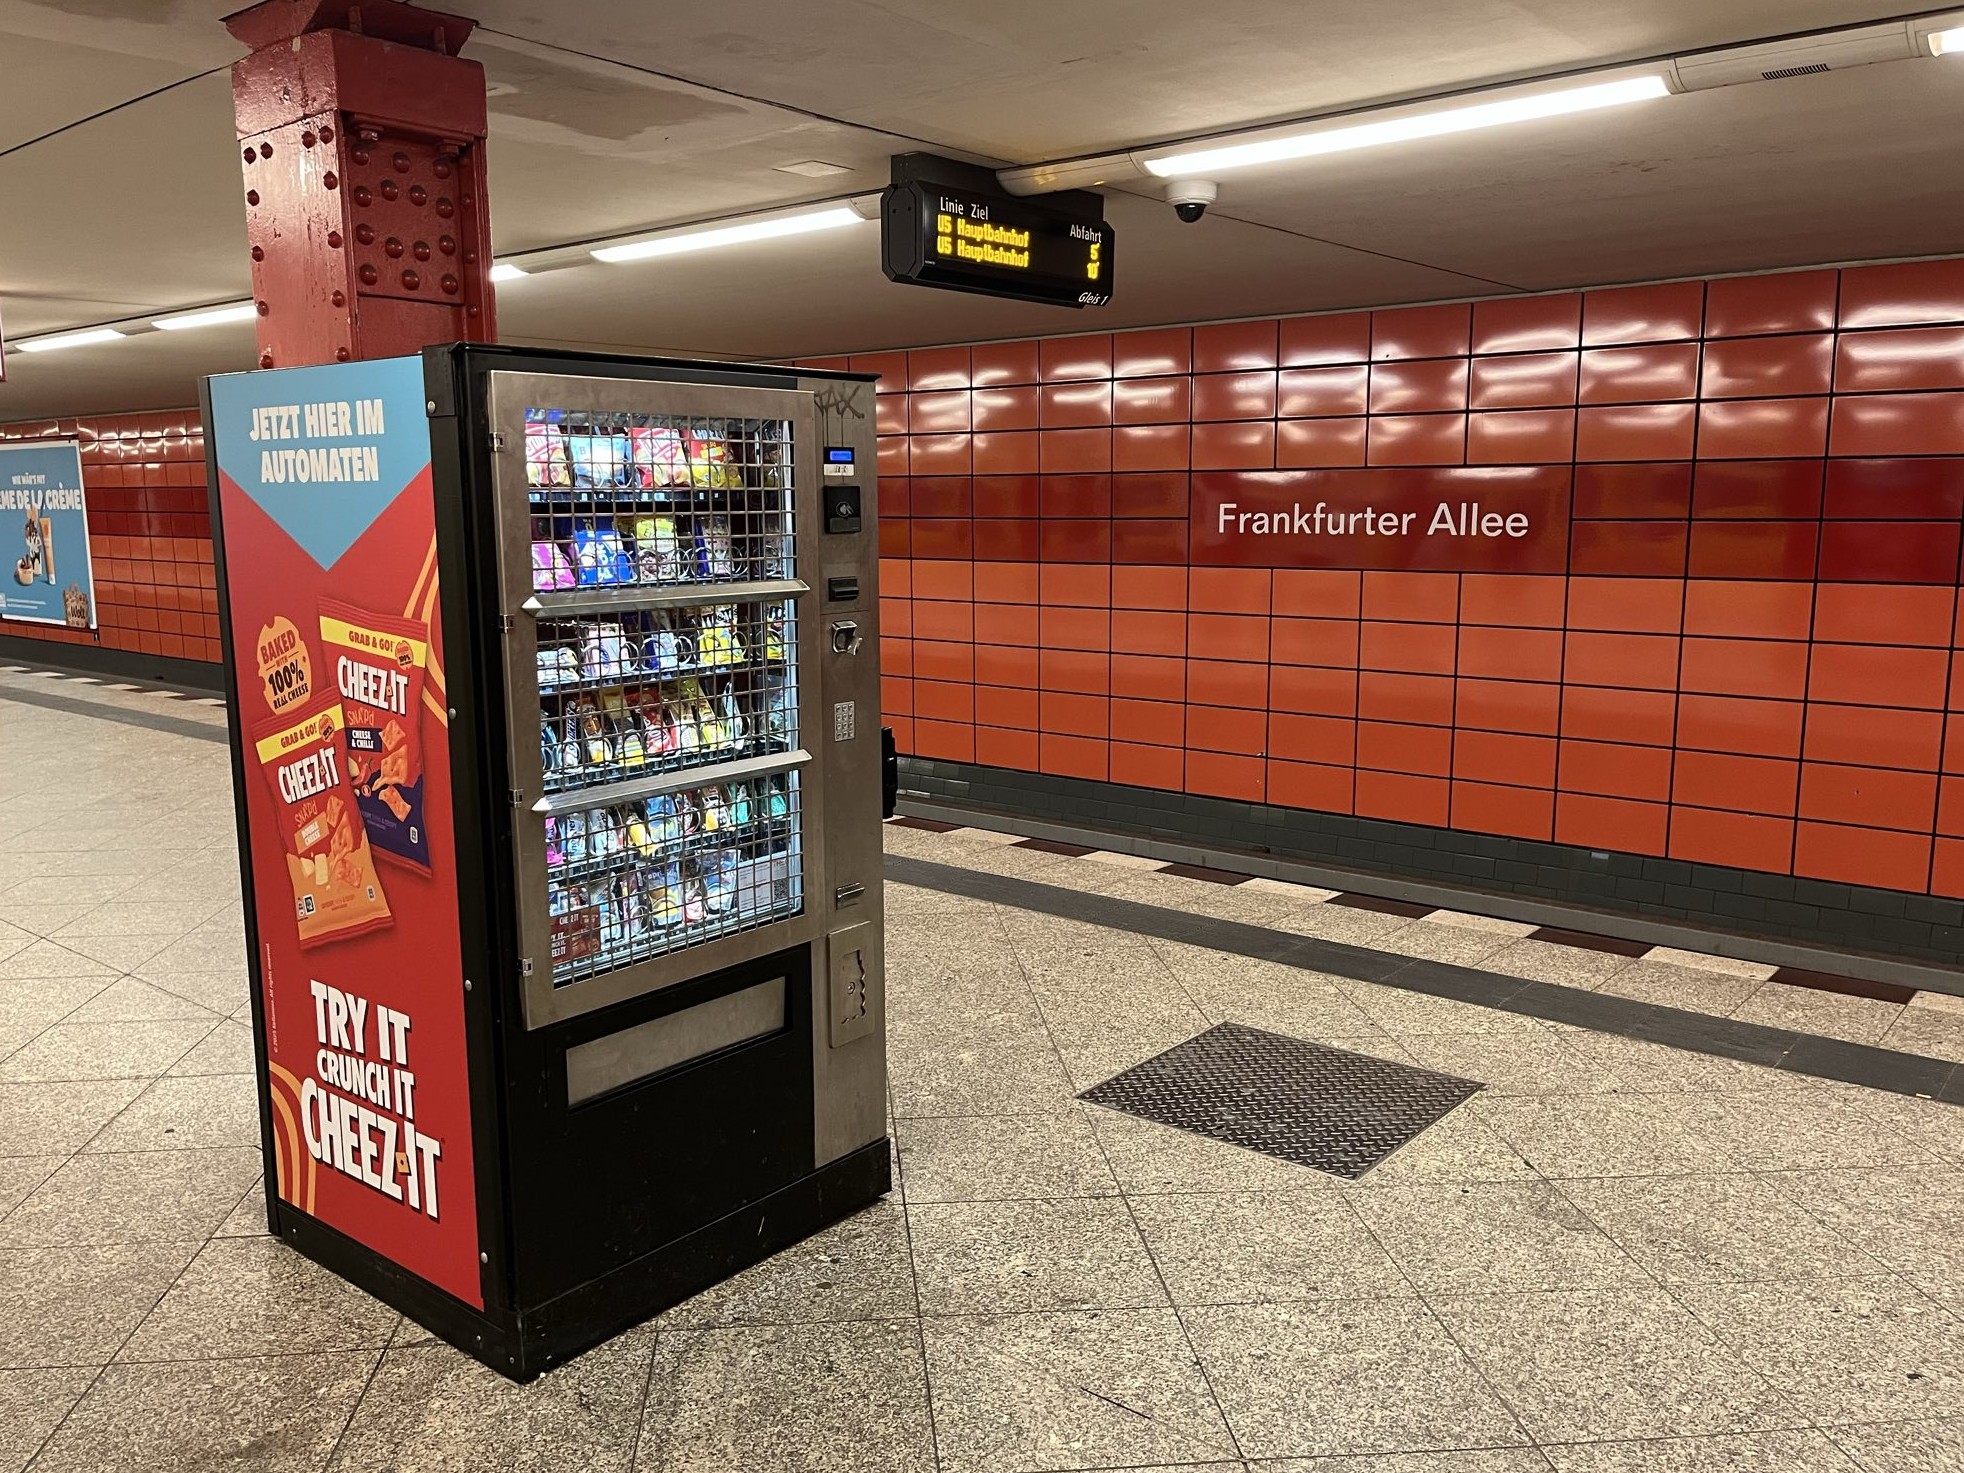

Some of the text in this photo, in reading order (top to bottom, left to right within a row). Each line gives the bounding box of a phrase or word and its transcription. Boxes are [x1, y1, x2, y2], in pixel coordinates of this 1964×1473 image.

[940, 196, 988, 220] Linie Ziel
[937, 214, 1029, 248] U5 Hauptbahnhof
[1069, 224, 1102, 244] Abfahrt
[937, 235, 1029, 268] U5 Hauptbahnhof
[1078, 292, 1101, 305] Gleis
[249, 399, 385, 441] JETZT HIER IM
[261, 446, 379, 484] AUTOMATEN
[17, 489, 30, 510] DE
[45, 482, 82, 510] CRÈME
[1218, 502, 1529, 538] Frankfurter Allee
[260, 629, 296, 664] BAKED
[348, 630, 370, 647] GRAB
[371, 637, 378, 649] &
[379, 638, 394, 653] GO!
[268, 659, 305, 696] 100%
[273, 683, 309, 710] REAL CHEESE
[280, 732, 299, 748] GRAB
[299, 729, 305, 740] &
[310, 979, 411, 1066] TRY IT
[316, 1048, 415, 1120] CRUNCH IT
